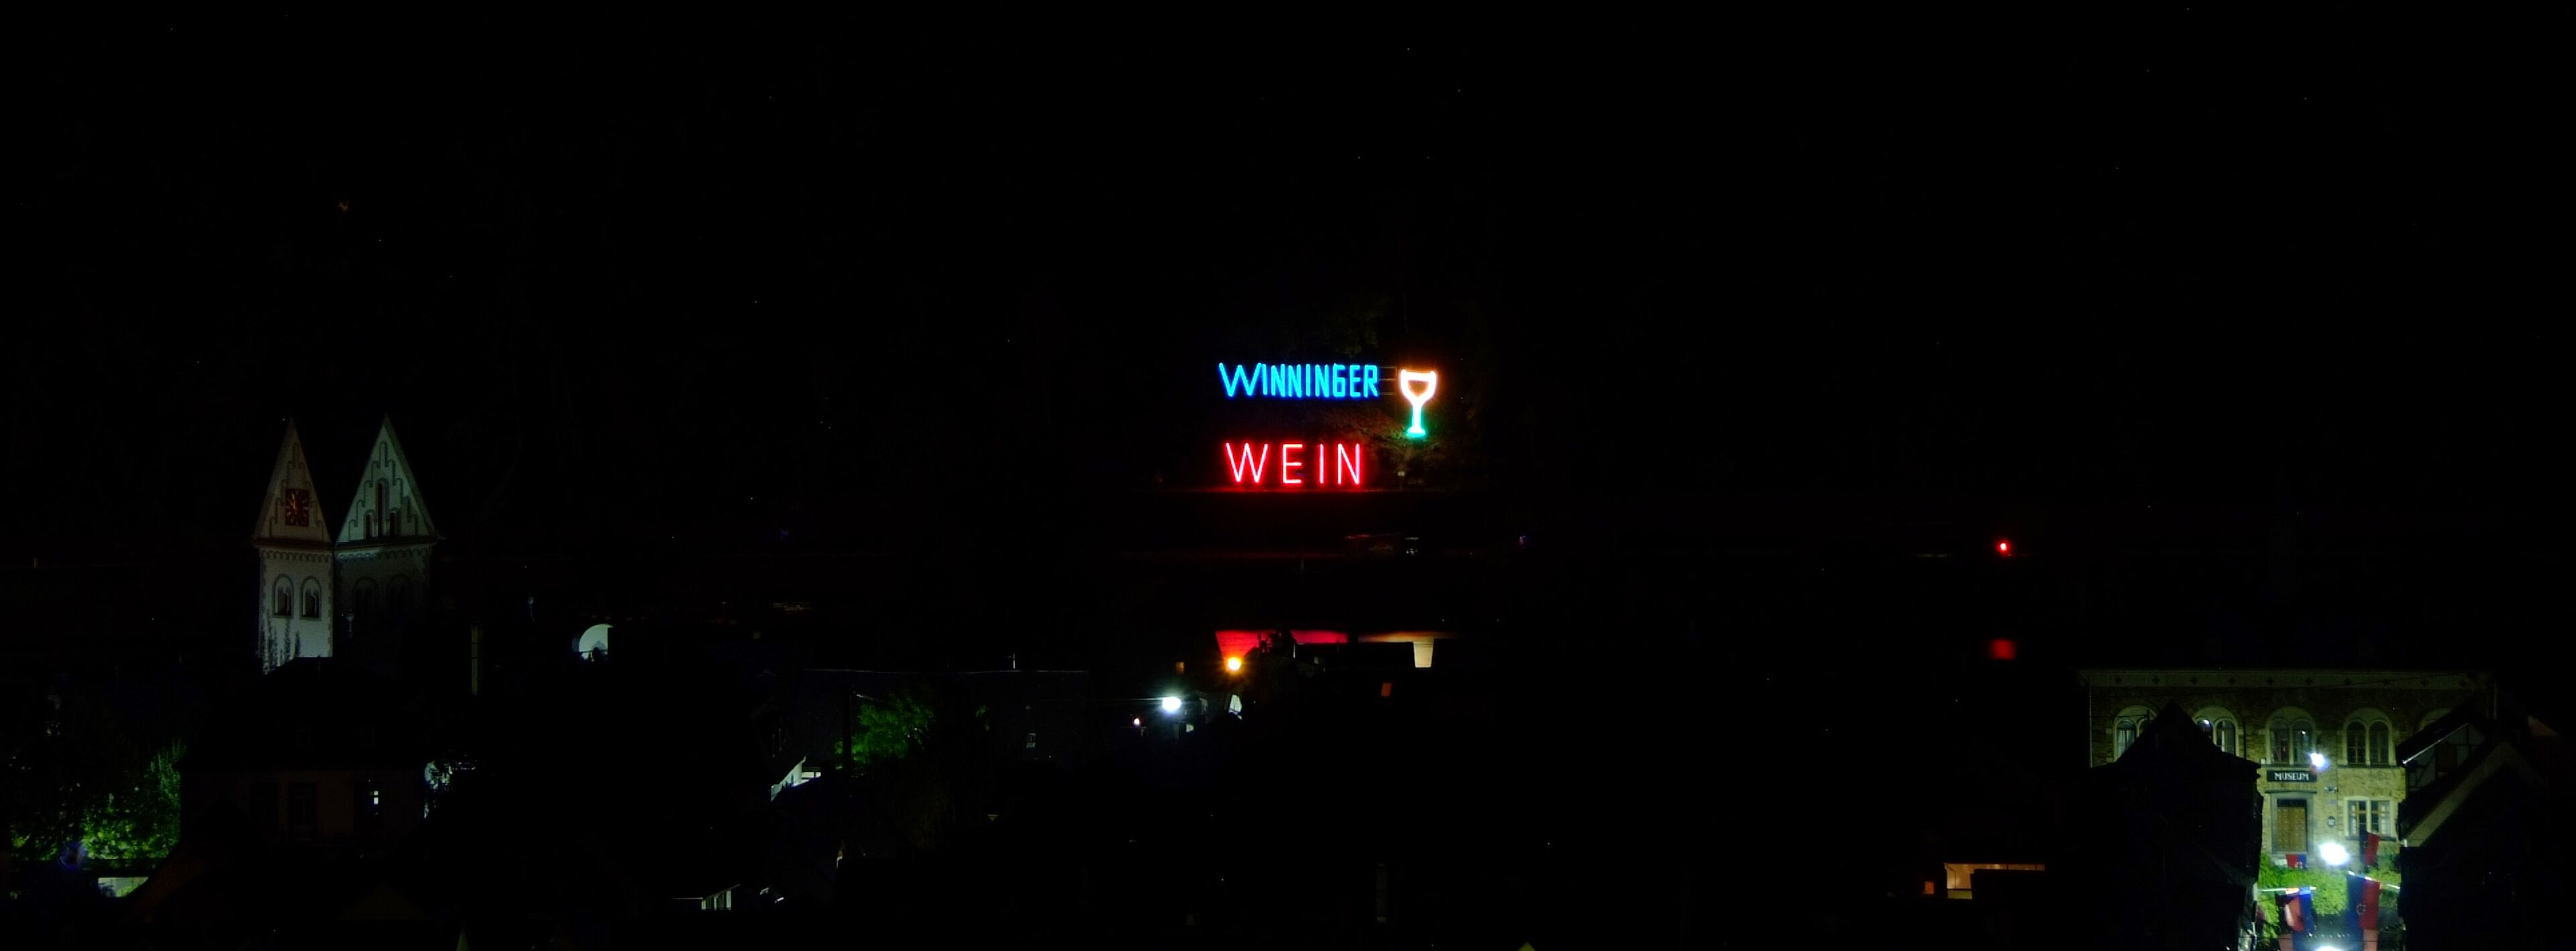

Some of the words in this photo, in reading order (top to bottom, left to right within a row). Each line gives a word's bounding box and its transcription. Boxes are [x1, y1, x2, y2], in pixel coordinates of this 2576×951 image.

[1218, 362, 1379, 398] WINNINGER
[1225, 442, 1362, 485] WEIN
[2273, 772, 2309, 781] MUSEUM
